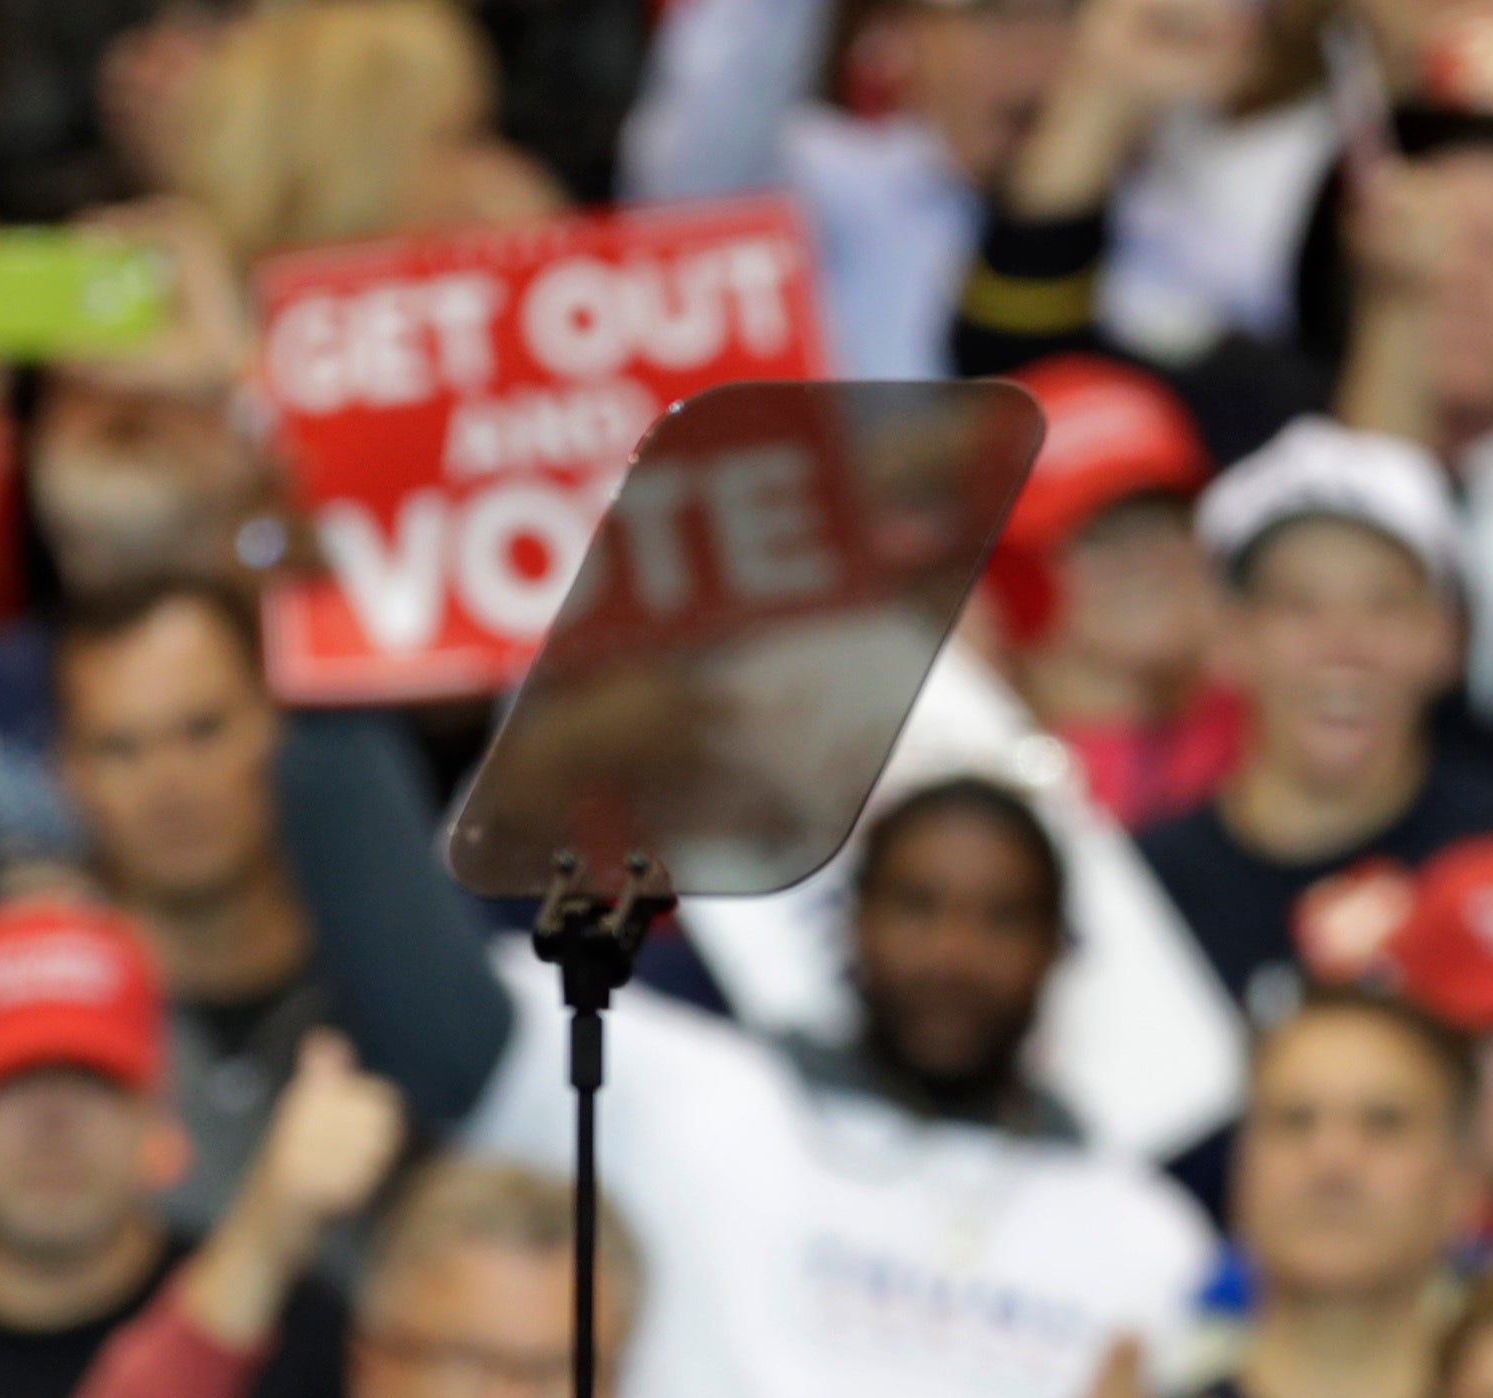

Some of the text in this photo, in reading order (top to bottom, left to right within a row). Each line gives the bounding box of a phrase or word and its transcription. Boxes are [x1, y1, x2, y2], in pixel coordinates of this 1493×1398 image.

[269, 240, 795, 412] GET OUT
[445, 376, 657, 482] AND
[319, 447, 842, 658] VOTE
